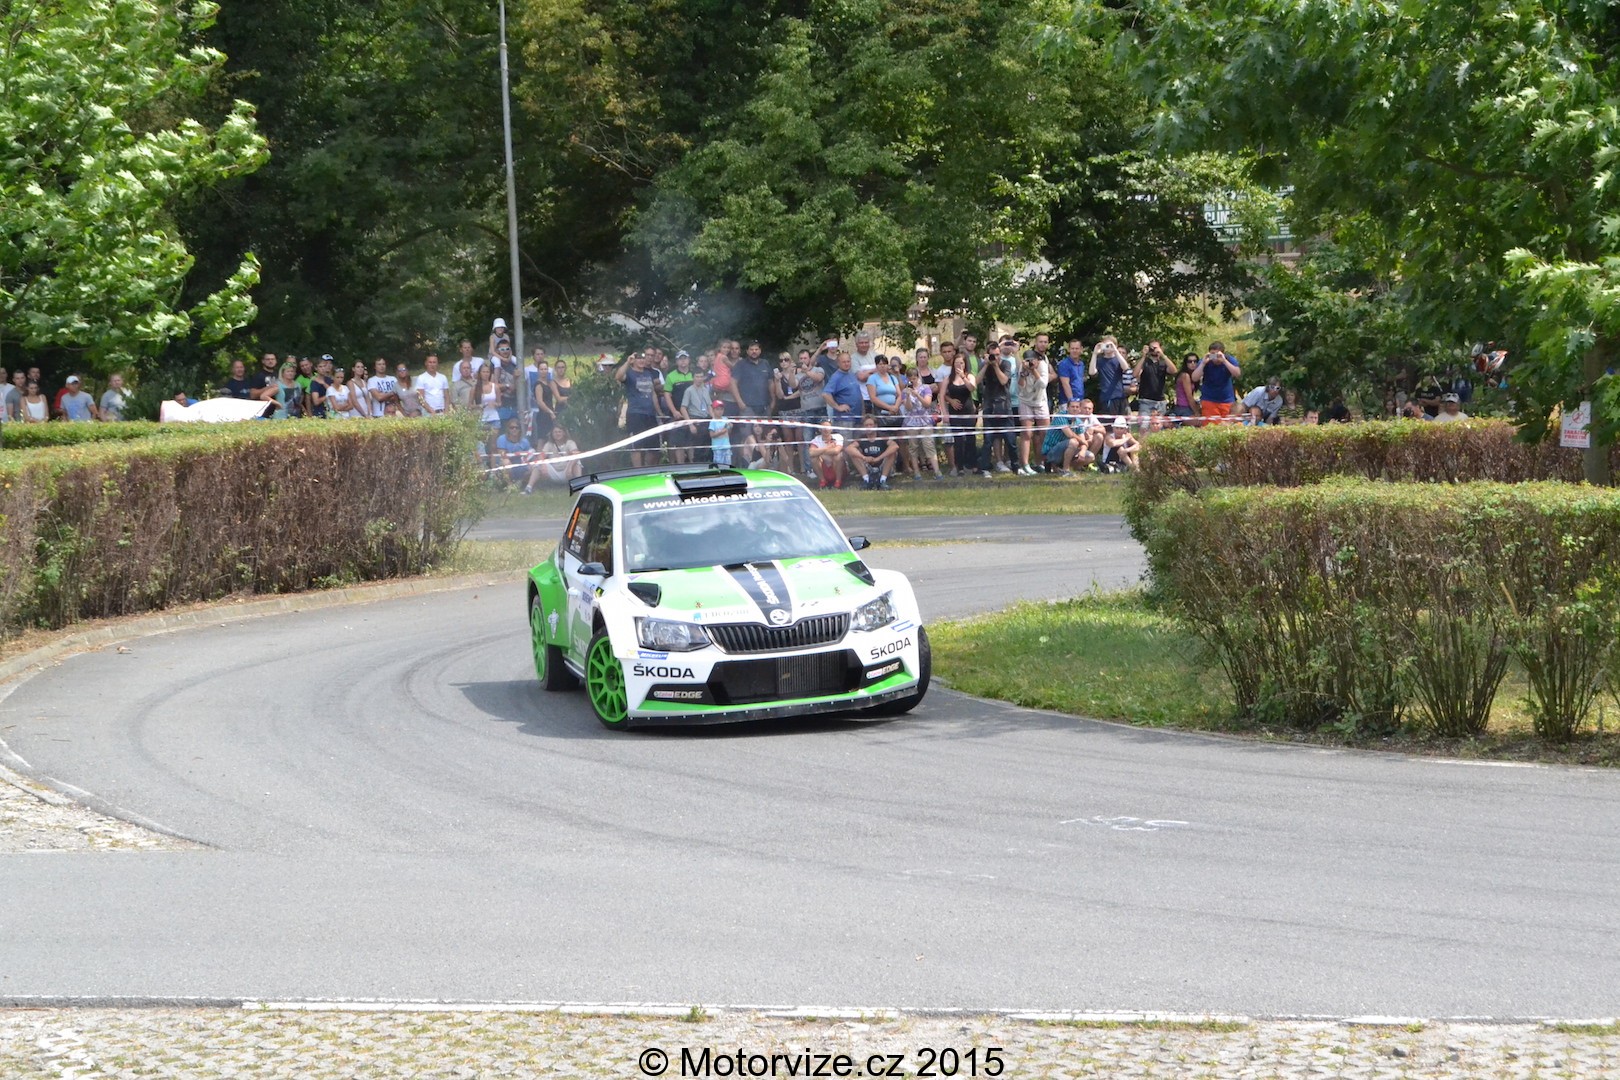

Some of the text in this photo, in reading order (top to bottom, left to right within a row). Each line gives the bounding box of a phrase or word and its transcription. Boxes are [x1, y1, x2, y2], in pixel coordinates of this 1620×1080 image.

[643, 488, 793, 509] www.skoda-auto.com
[871, 637, 911, 660] ŠKODA
[633, 662, 695, 679] ŠKODA
[674, 690, 703, 699] EDGE
